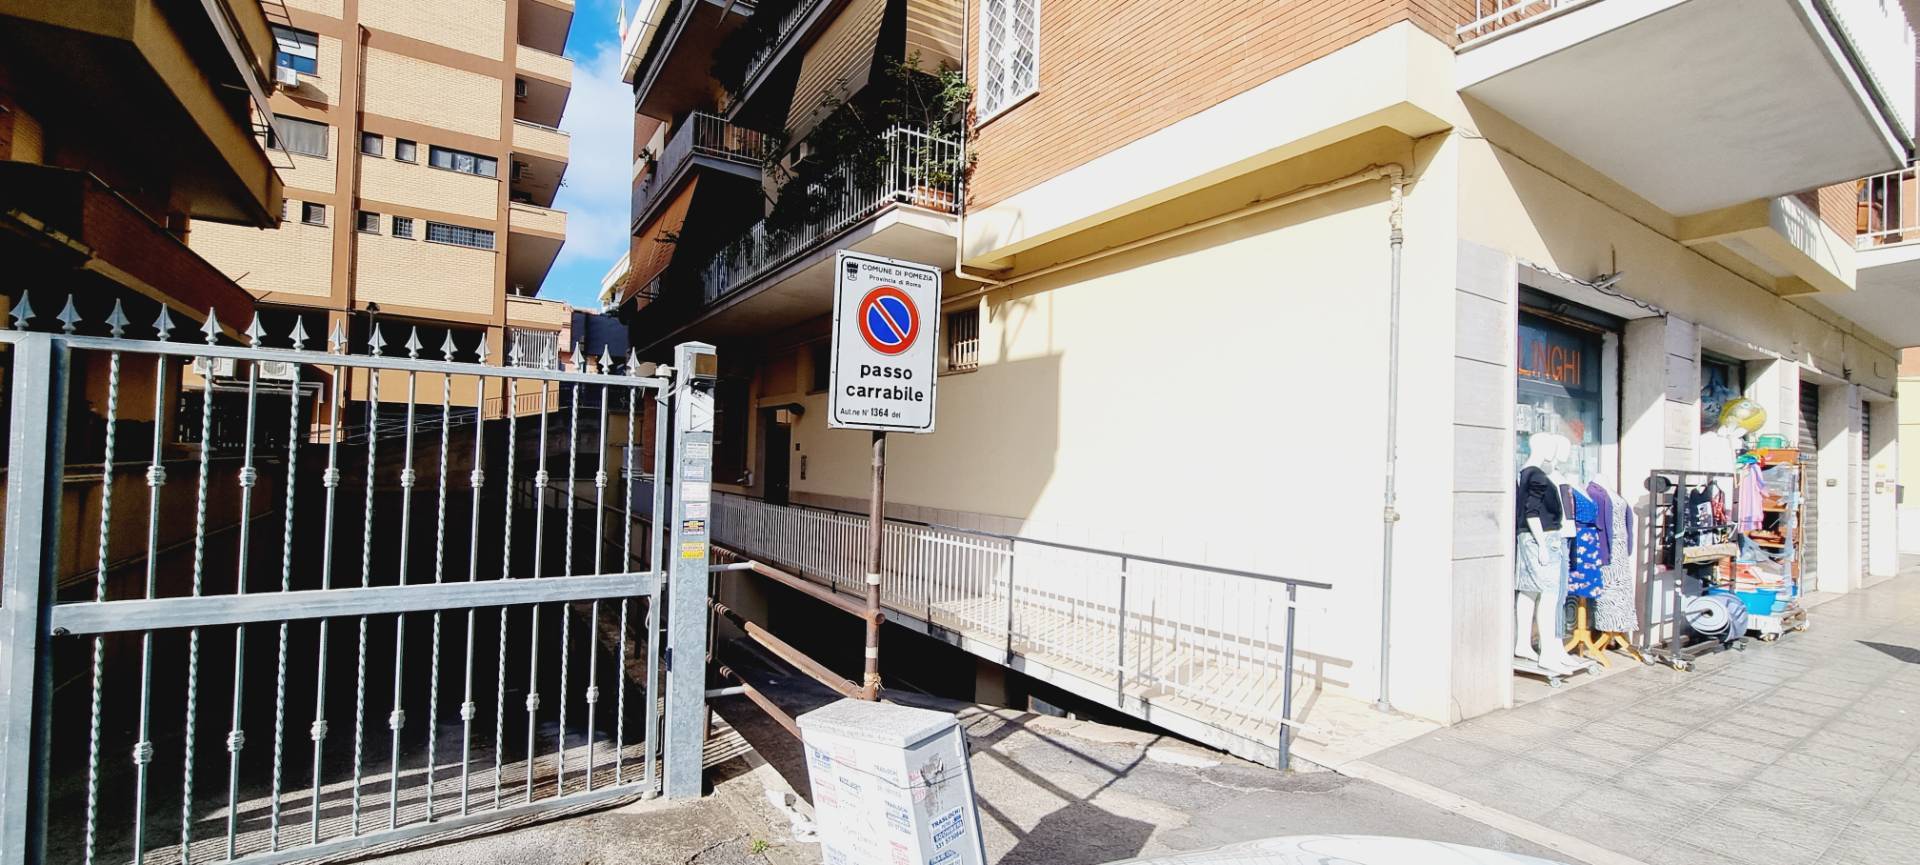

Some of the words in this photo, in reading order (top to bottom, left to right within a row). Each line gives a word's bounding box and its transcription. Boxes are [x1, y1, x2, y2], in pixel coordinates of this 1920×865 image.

[862, 263, 893, 276] COMUNE
[904, 271, 933, 282] POMEZIA
[869, 274, 896, 284] Provincia
[906, 280, 922, 289] Roma
[860, 364, 913, 380] passo
[846, 385, 924, 402] carrabile
[870, 407, 889, 418] 1364
